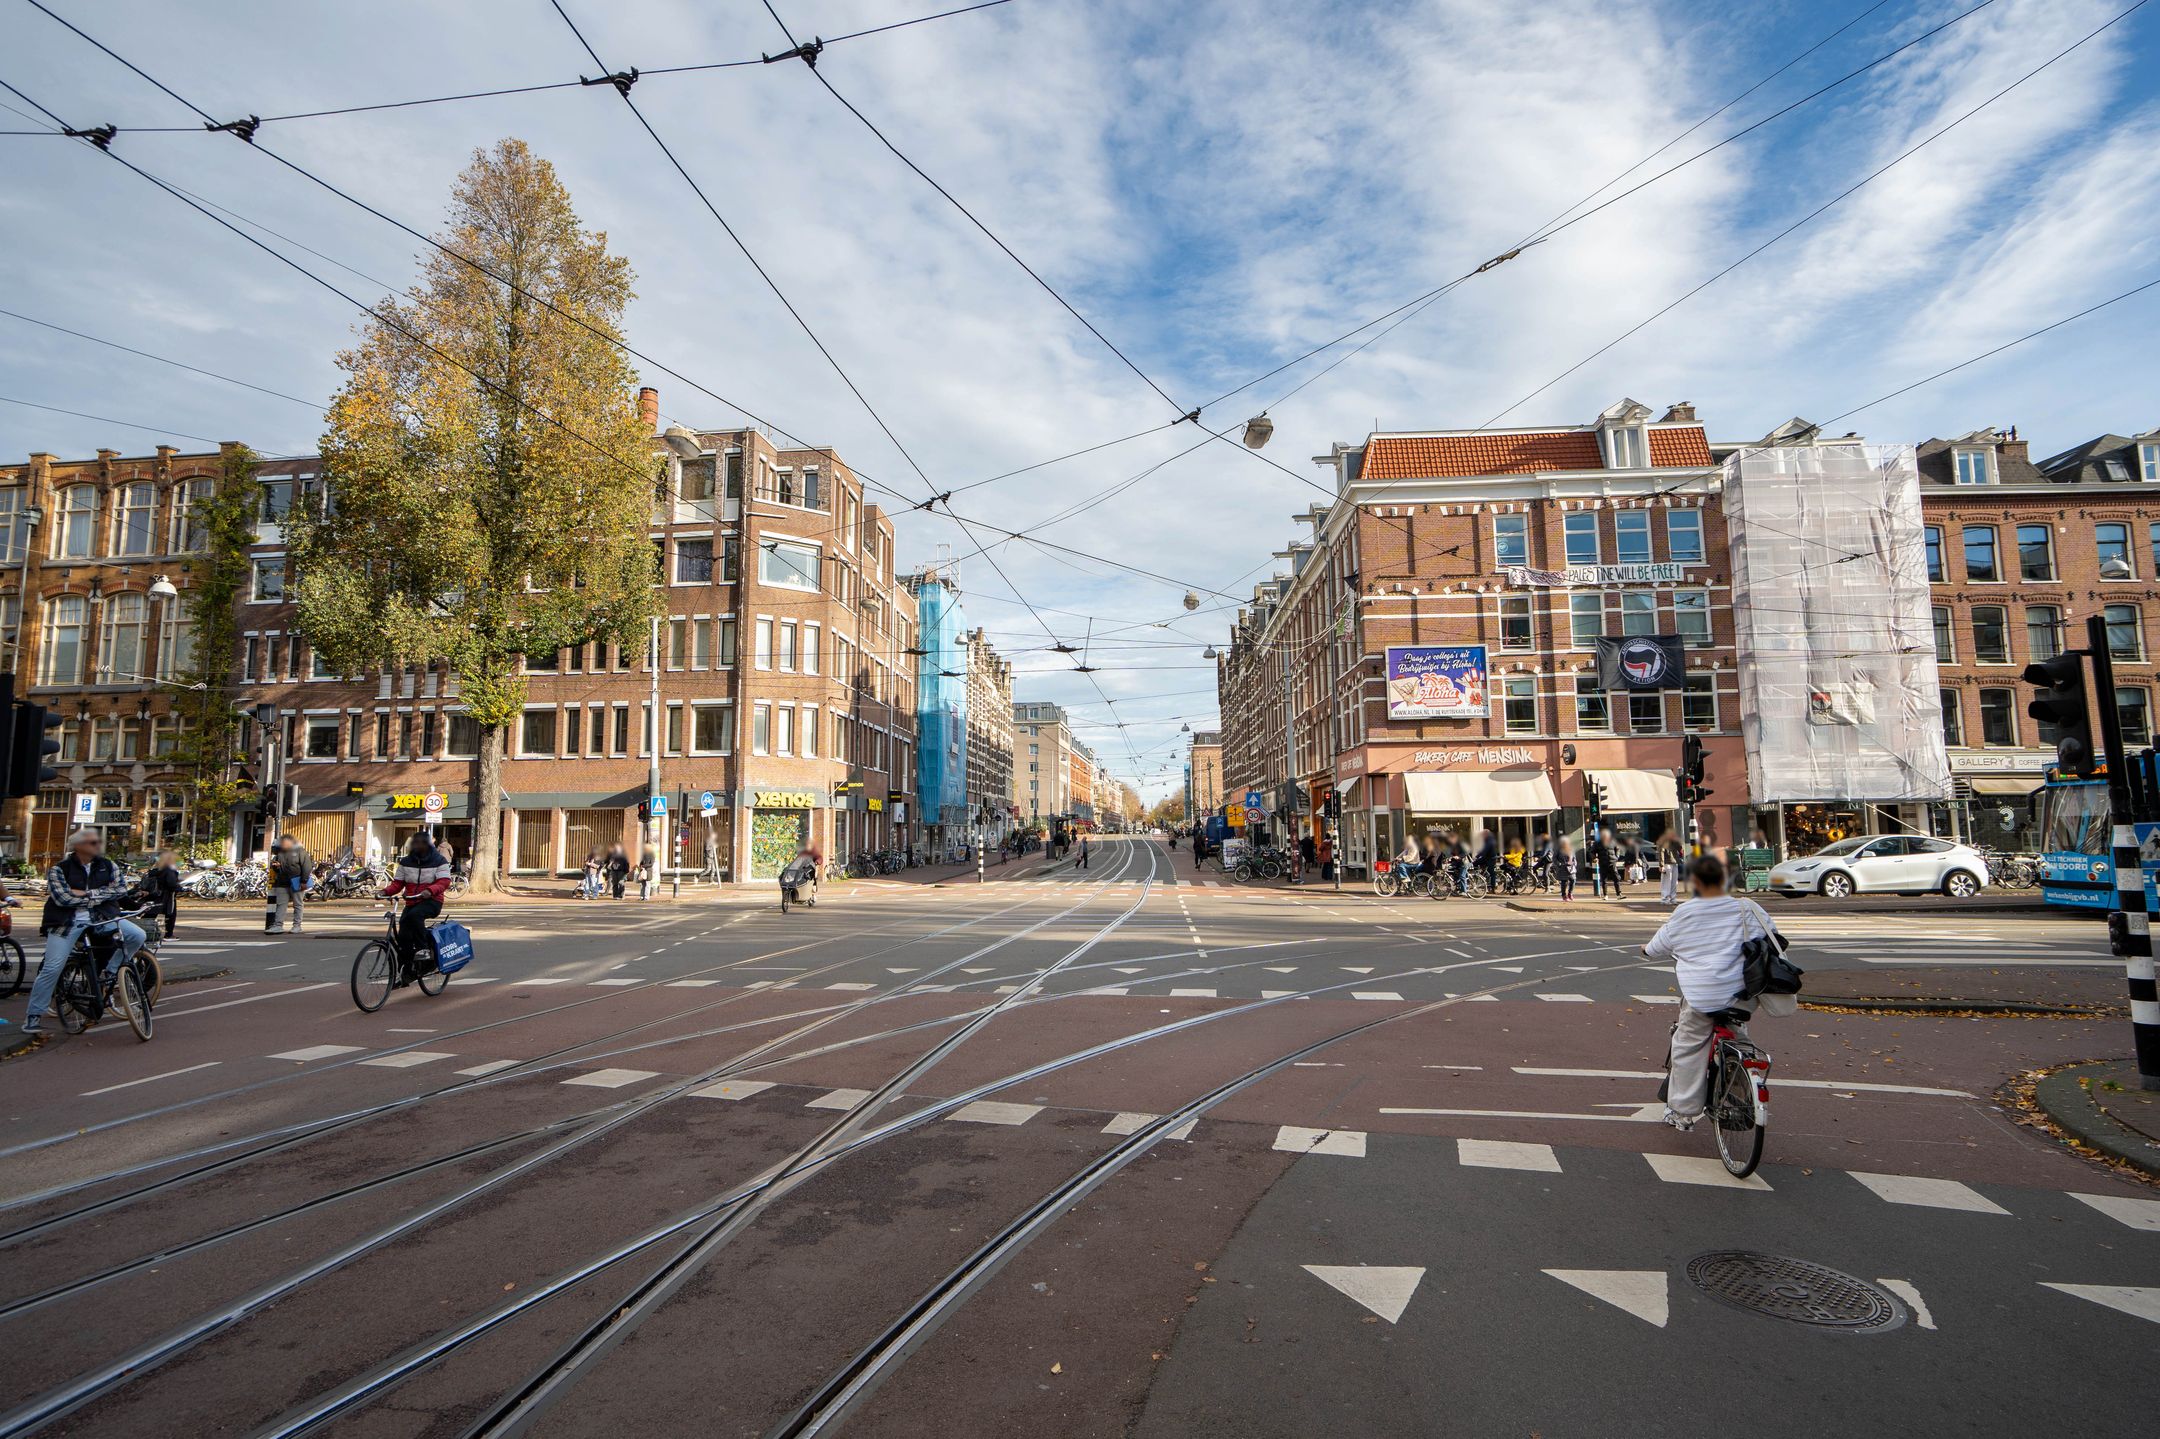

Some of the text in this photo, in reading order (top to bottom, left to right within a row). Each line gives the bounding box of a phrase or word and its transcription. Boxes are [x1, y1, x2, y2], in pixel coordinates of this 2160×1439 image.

[1568, 567, 1613, 583] PALESTINE
[1614, 567, 1636, 580] WILL
[1637, 566, 1650, 580] BE
[1632, 676, 1656, 684] AKTION
[1420, 686, 1457, 701] Aloha
[1414, 751, 1449, 764] BAKERY
[1477, 747, 1535, 764] MENSINK
[1958, 758, 2003, 766] GALLERY
[2004, 755, 2015, 769] 3
[392, 794, 449, 808] xens
[754, 791, 815, 807] xenos
[868, 798, 882, 811] xenos
[2058, 863, 2088, 871] BOORD
[2047, 892, 2099, 902] werkenbijgvb.nl
